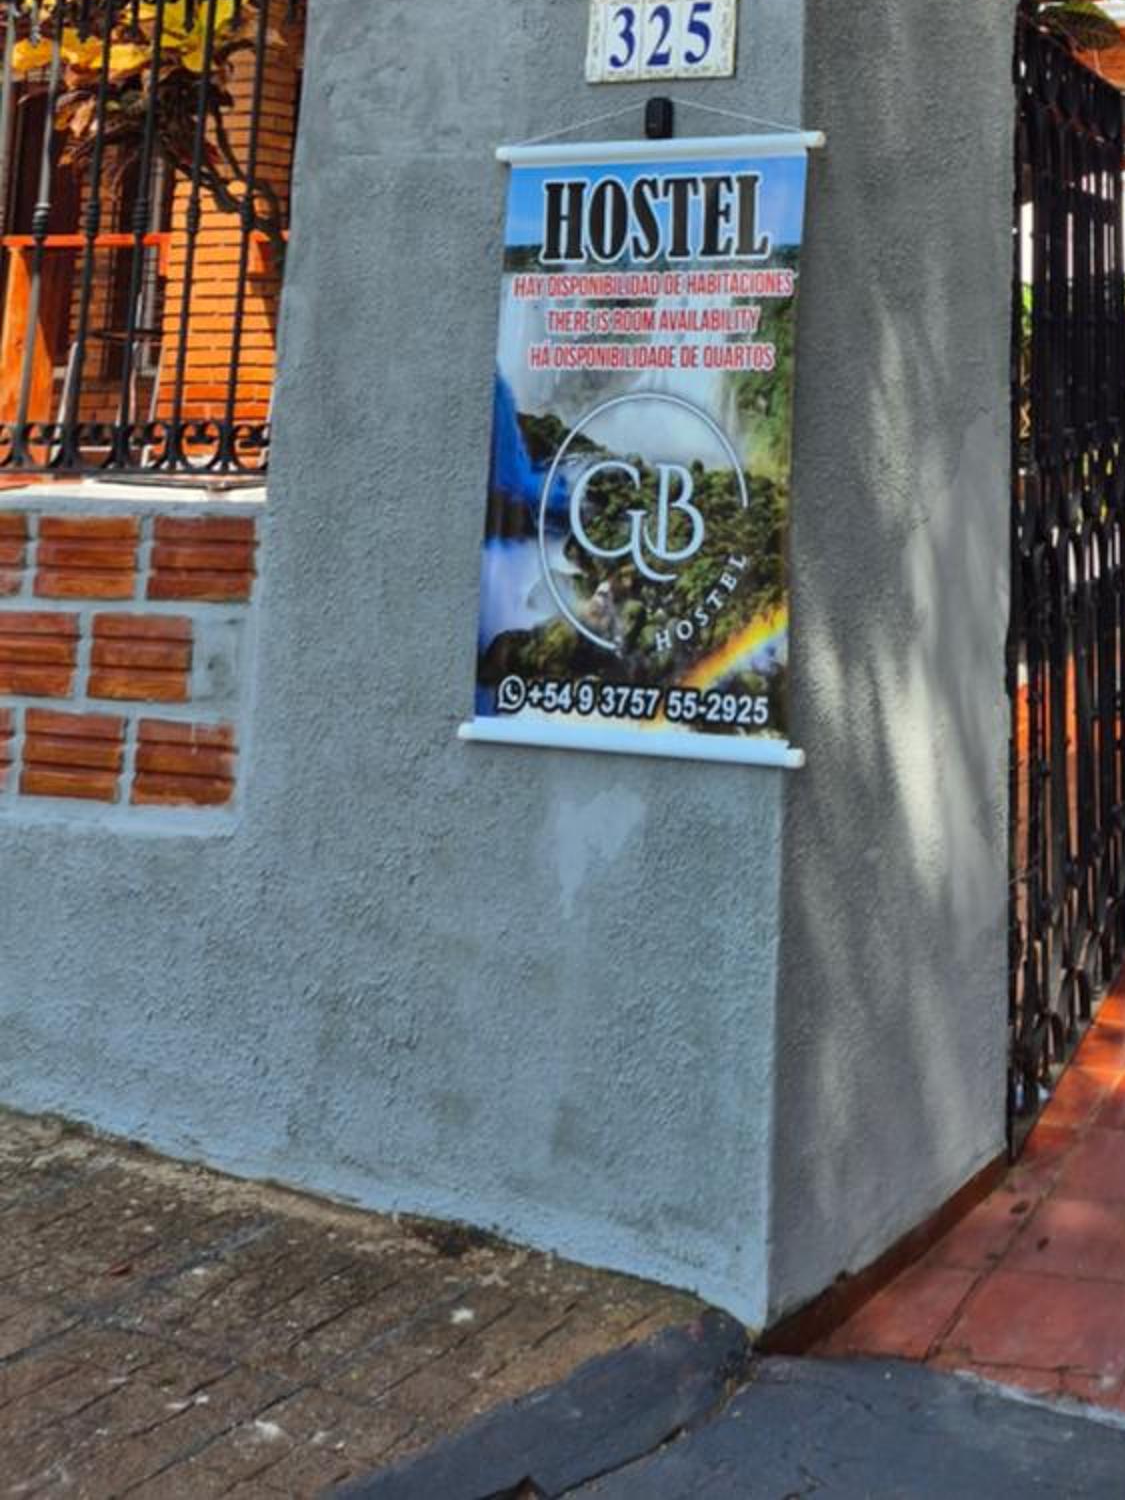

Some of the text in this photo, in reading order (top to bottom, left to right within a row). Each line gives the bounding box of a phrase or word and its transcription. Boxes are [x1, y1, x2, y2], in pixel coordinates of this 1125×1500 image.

[609, 2, 713, 68] 325
[541, 175, 769, 261] HOSTEL
[514, 271, 793, 297] HAY DISPONIBILIDAD DE HABITACIONES
[547, 307, 760, 332] THERE IS ROOM AVAILABILITY
[530, 341, 774, 369] HÁ DISPONIBILIDADE DE QUARTOS
[570, 461, 705, 582] GB
[655, 554, 750, 652] HOSTEL
[528, 682, 769, 725] +54 9 3757 55-2925
